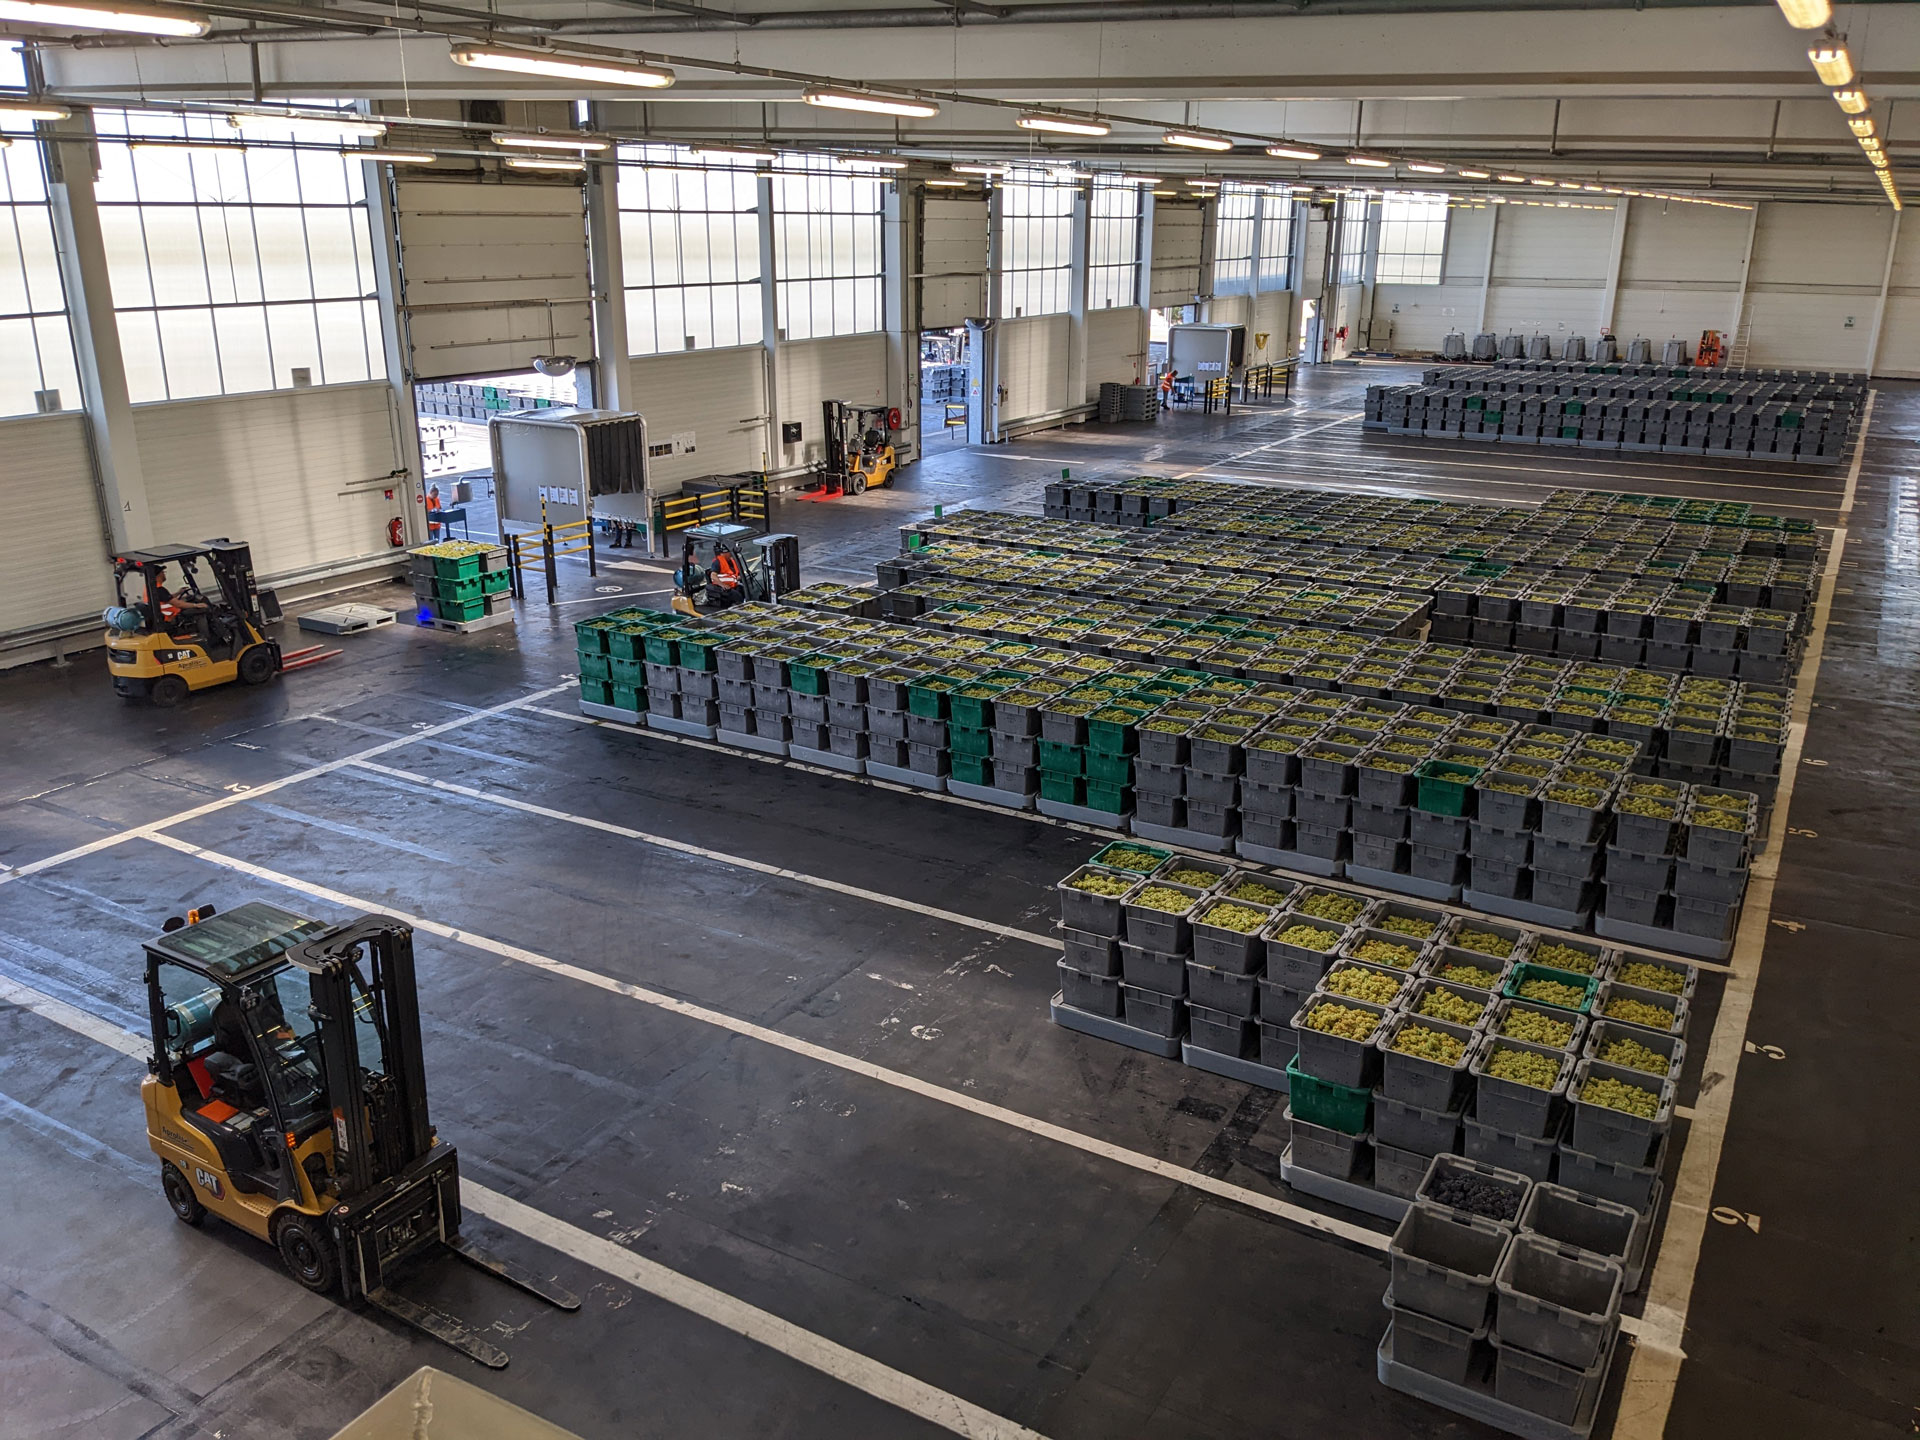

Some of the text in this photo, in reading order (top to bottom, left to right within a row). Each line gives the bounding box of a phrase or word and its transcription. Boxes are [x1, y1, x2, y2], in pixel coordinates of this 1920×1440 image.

[123, 499, 132, 512] 1
[177, 649, 191, 661] CAT
[1802, 758, 1829, 766] 6
[223, 782, 251, 793] 2
[1788, 827, 1818, 838] 5
[1771, 919, 1806, 935] 4
[1744, 1040, 1786, 1060] 3
[195, 1167, 219, 1194] CAT
[1711, 1206, 1761, 1234] 2
